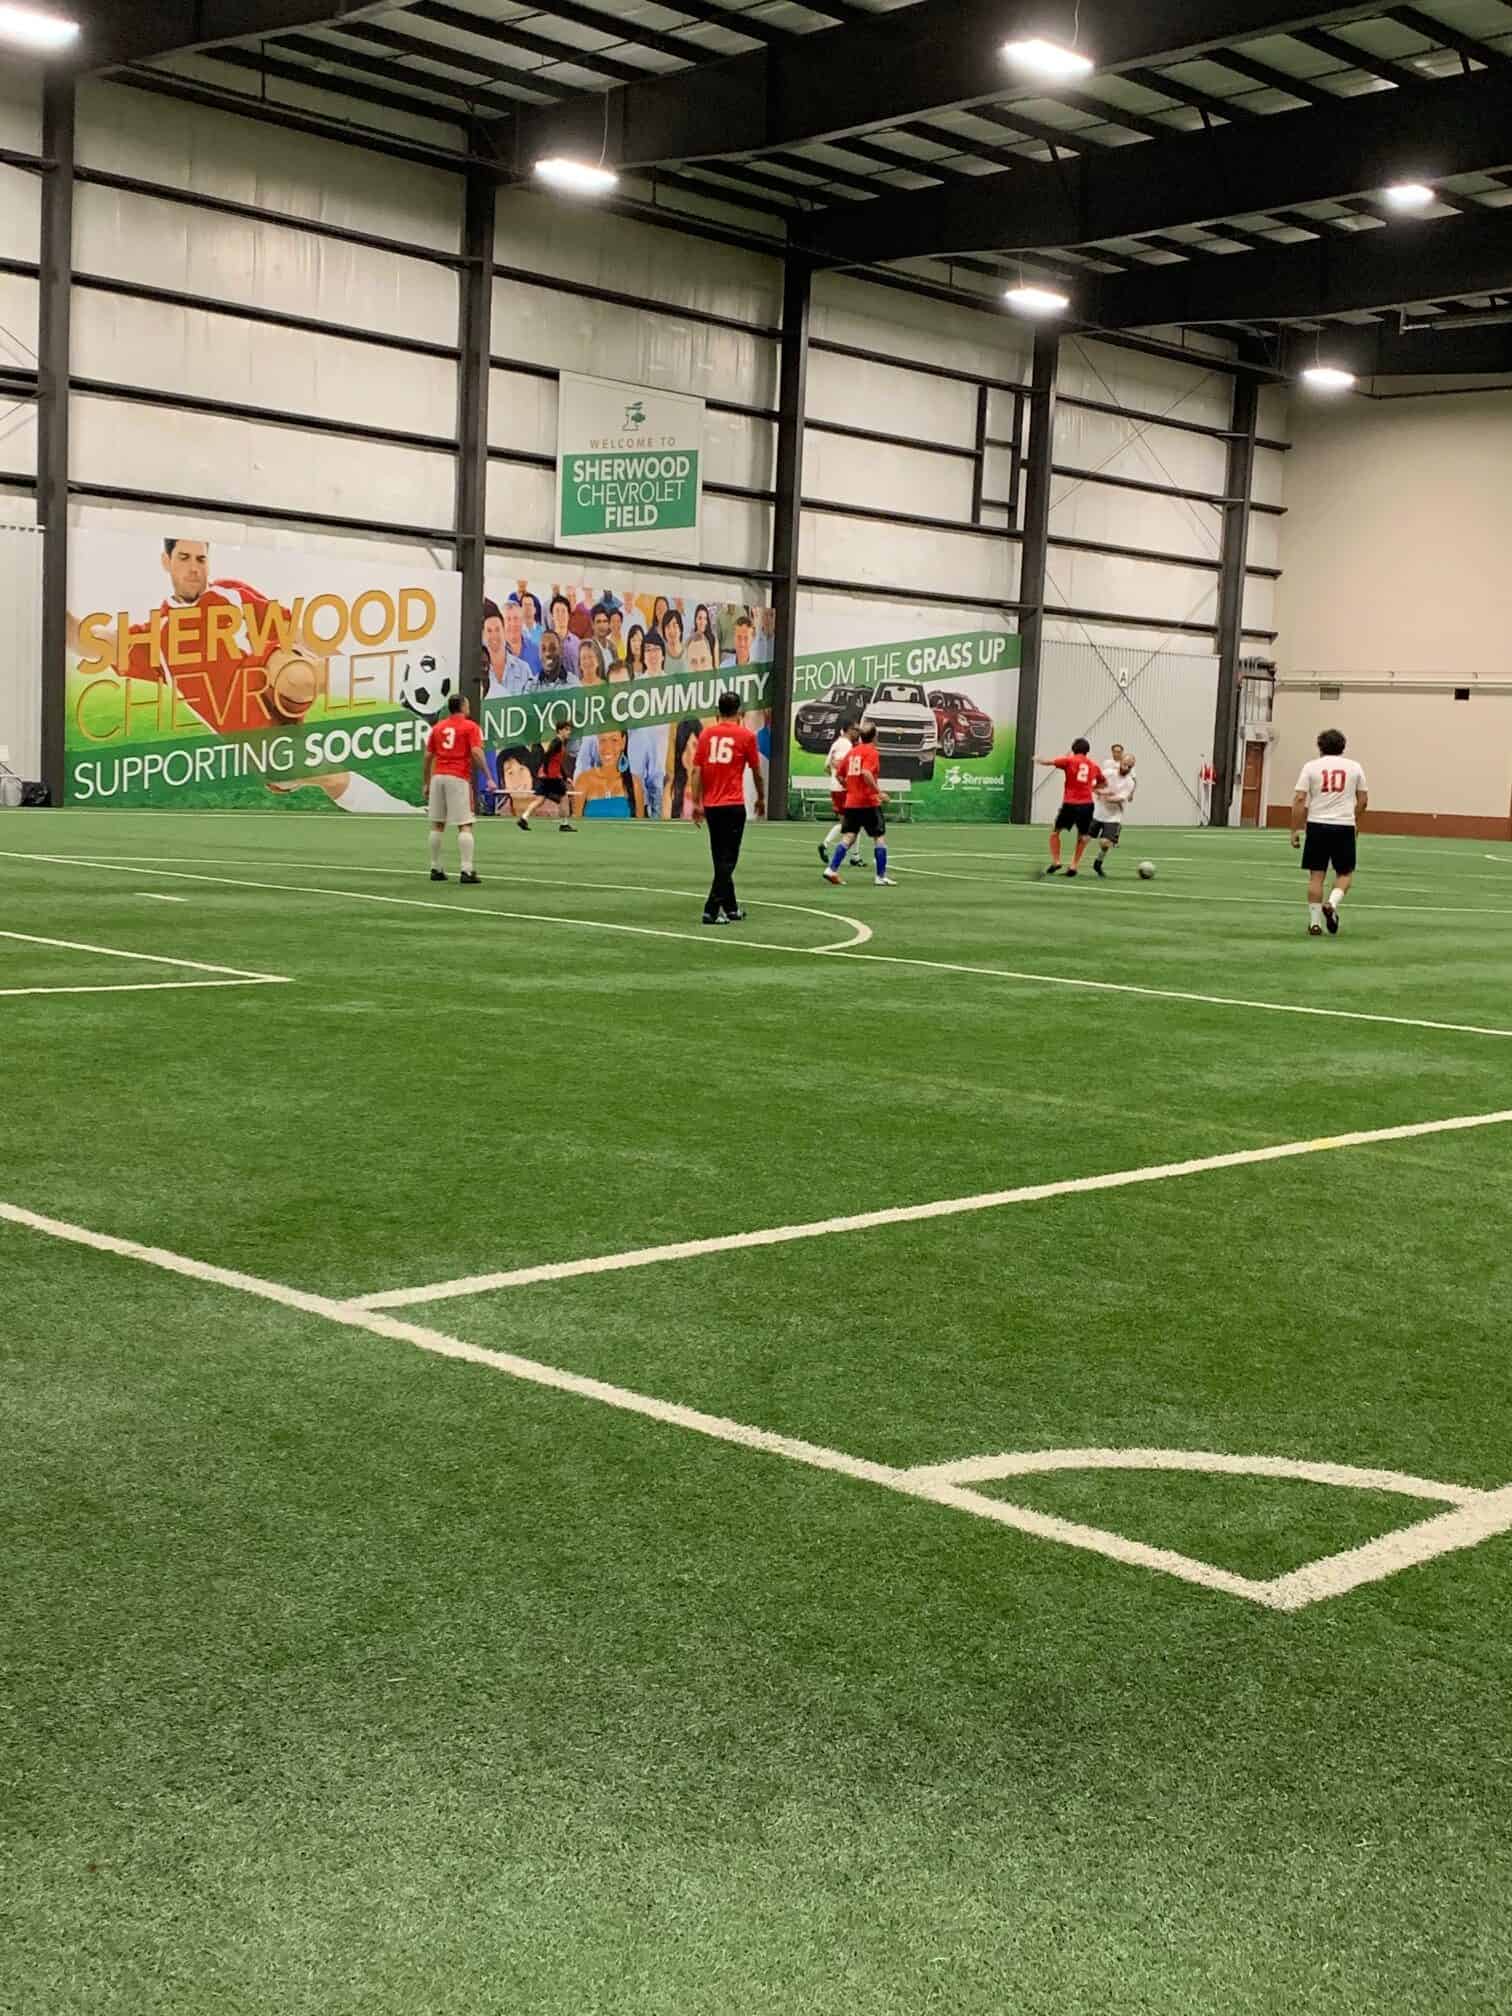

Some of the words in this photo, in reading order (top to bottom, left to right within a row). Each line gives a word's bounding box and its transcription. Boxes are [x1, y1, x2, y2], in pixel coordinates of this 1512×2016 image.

[590, 438, 654, 449] WELCOME
[661, 436, 676, 447] TO
[573, 456, 690, 482] SHERWOOD
[577, 479, 685, 506] CHEVROLET
[605, 504, 658, 528] FIELD
[77, 587, 436, 676] SHERWOOD
[793, 658, 856, 693] FROM
[862, 652, 901, 681] THE
[907, 641, 973, 676] GRASS
[978, 637, 1006, 665] UP
[76, 648, 409, 741] CHEVROLET
[533, 695, 605, 733] YOUR
[611, 672, 770, 722] COMMUNITY
[441, 727, 457, 750] 3
[708, 736, 735, 764] 16
[73, 736, 294, 800] SUPPORTING
[304, 719, 433, 767] SOCCER
[1076, 763, 1089, 783] 2
[1320, 769, 1346, 793] 10
